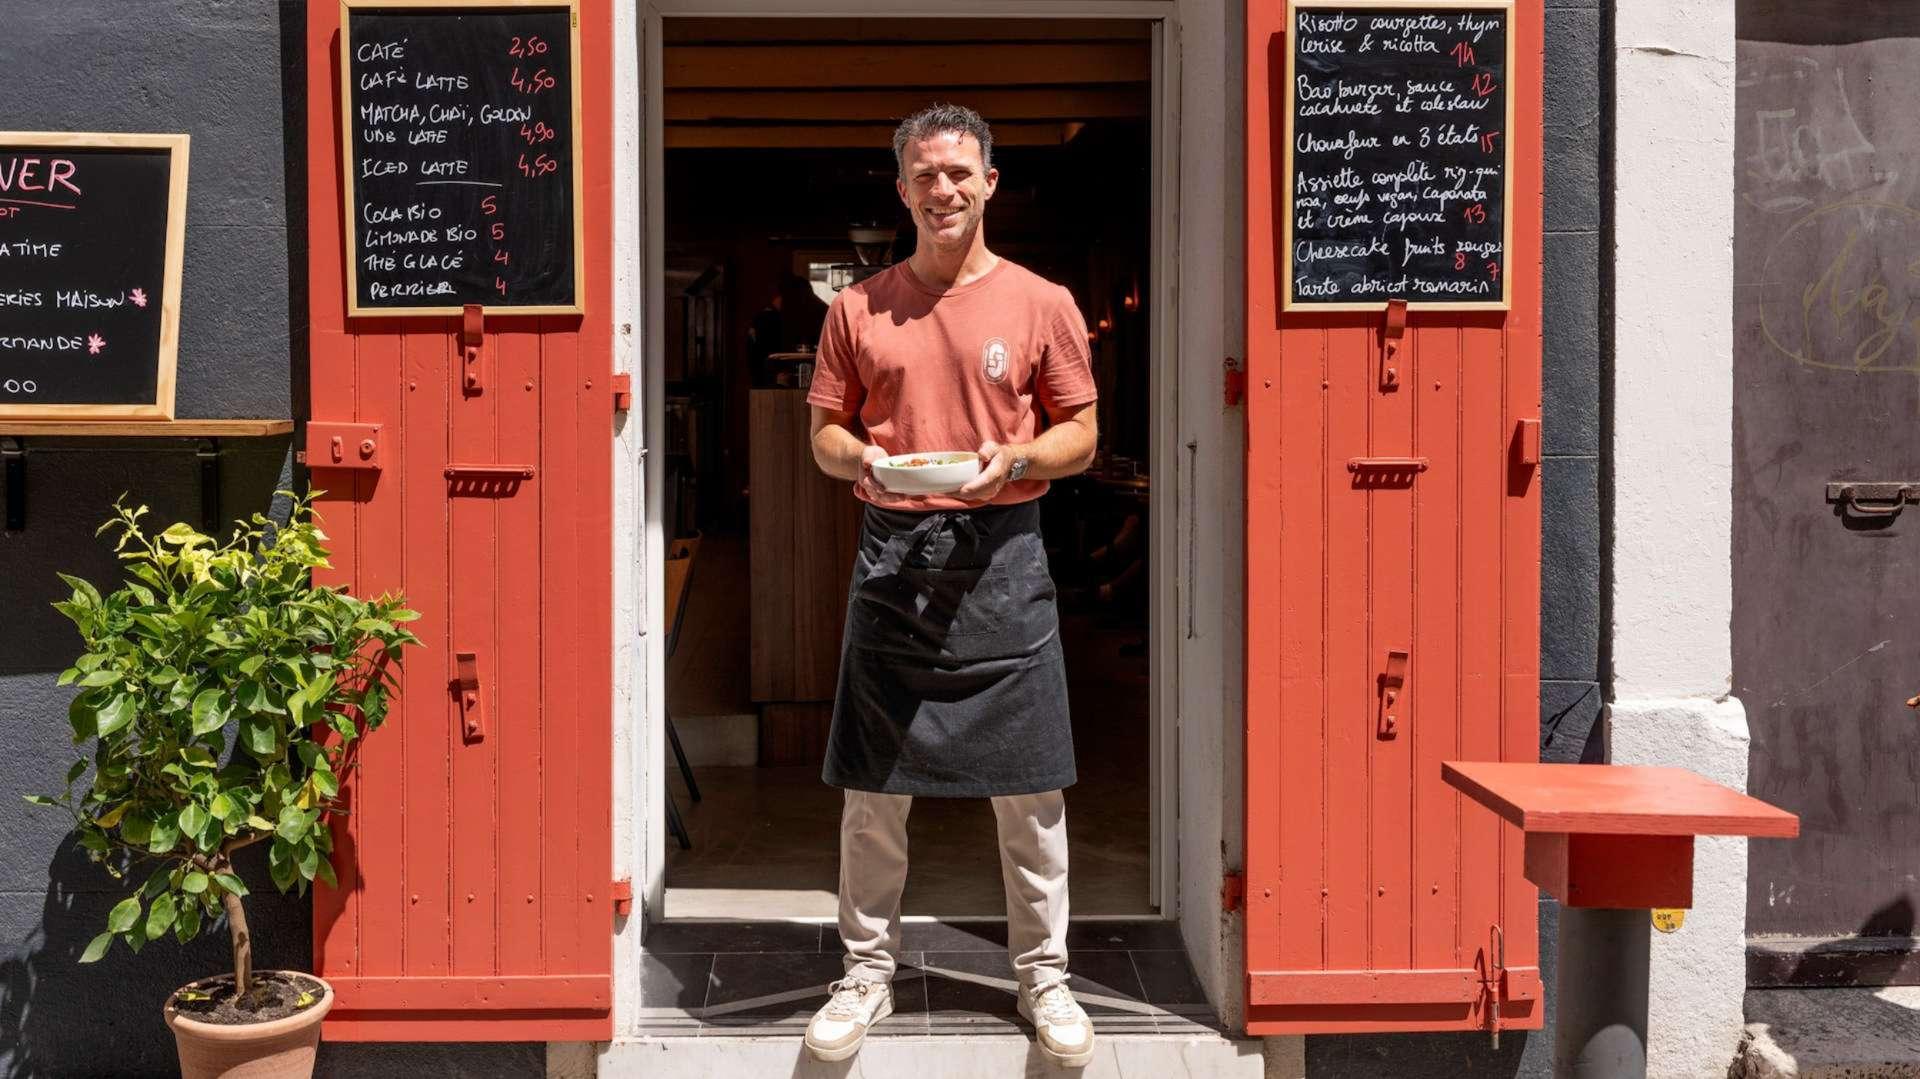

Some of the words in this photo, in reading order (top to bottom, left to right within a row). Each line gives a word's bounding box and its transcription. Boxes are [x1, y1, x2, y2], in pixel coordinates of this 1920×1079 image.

[1299, 12, 1358, 33] Risotto
[509, 37, 548, 59] 2,50
[1359, 34, 1374, 53] &
[1383, 35, 1440, 53] ricotta
[415, 72, 469, 92] LATTE
[511, 68, 555, 93] 4,50
[1297, 74, 1331, 101] Bao
[1471, 73, 1498, 97] 12
[1396, 99, 1411, 113] et
[408, 130, 448, 145] LATTE
[520, 122, 554, 145] 4,90
[1392, 134, 1411, 147] en
[1419, 127, 1431, 147] 3
[1437, 124, 1479, 145] états
[1480, 131, 1499, 154] 15
[362, 158, 408, 178] ICED
[421, 160, 468, 175] LATTE
[518, 153, 557, 178] 4,50
[1297, 167, 1363, 195] Assiette
[364, 202, 403, 223] COLA
[481, 195, 497, 214] 5
[1298, 210, 1314, 230] et
[1327, 208, 1373, 229] crème
[1464, 204, 1486, 225] 13
[491, 222, 505, 240] 5
[403, 250, 463, 270] GLACÉ
[494, 250, 508, 265] 4
[1296, 236, 1390, 262] Cheesecake
[1402, 236, 1445, 267] fruits
[1454, 252, 1467, 271] 8
[495, 276, 506, 296] 4
[1296, 275, 1340, 296] Tarte
[1351, 274, 1408, 294] abricot
[1415, 278, 1489, 294] romarin
[1486, 261, 1500, 281] 7
